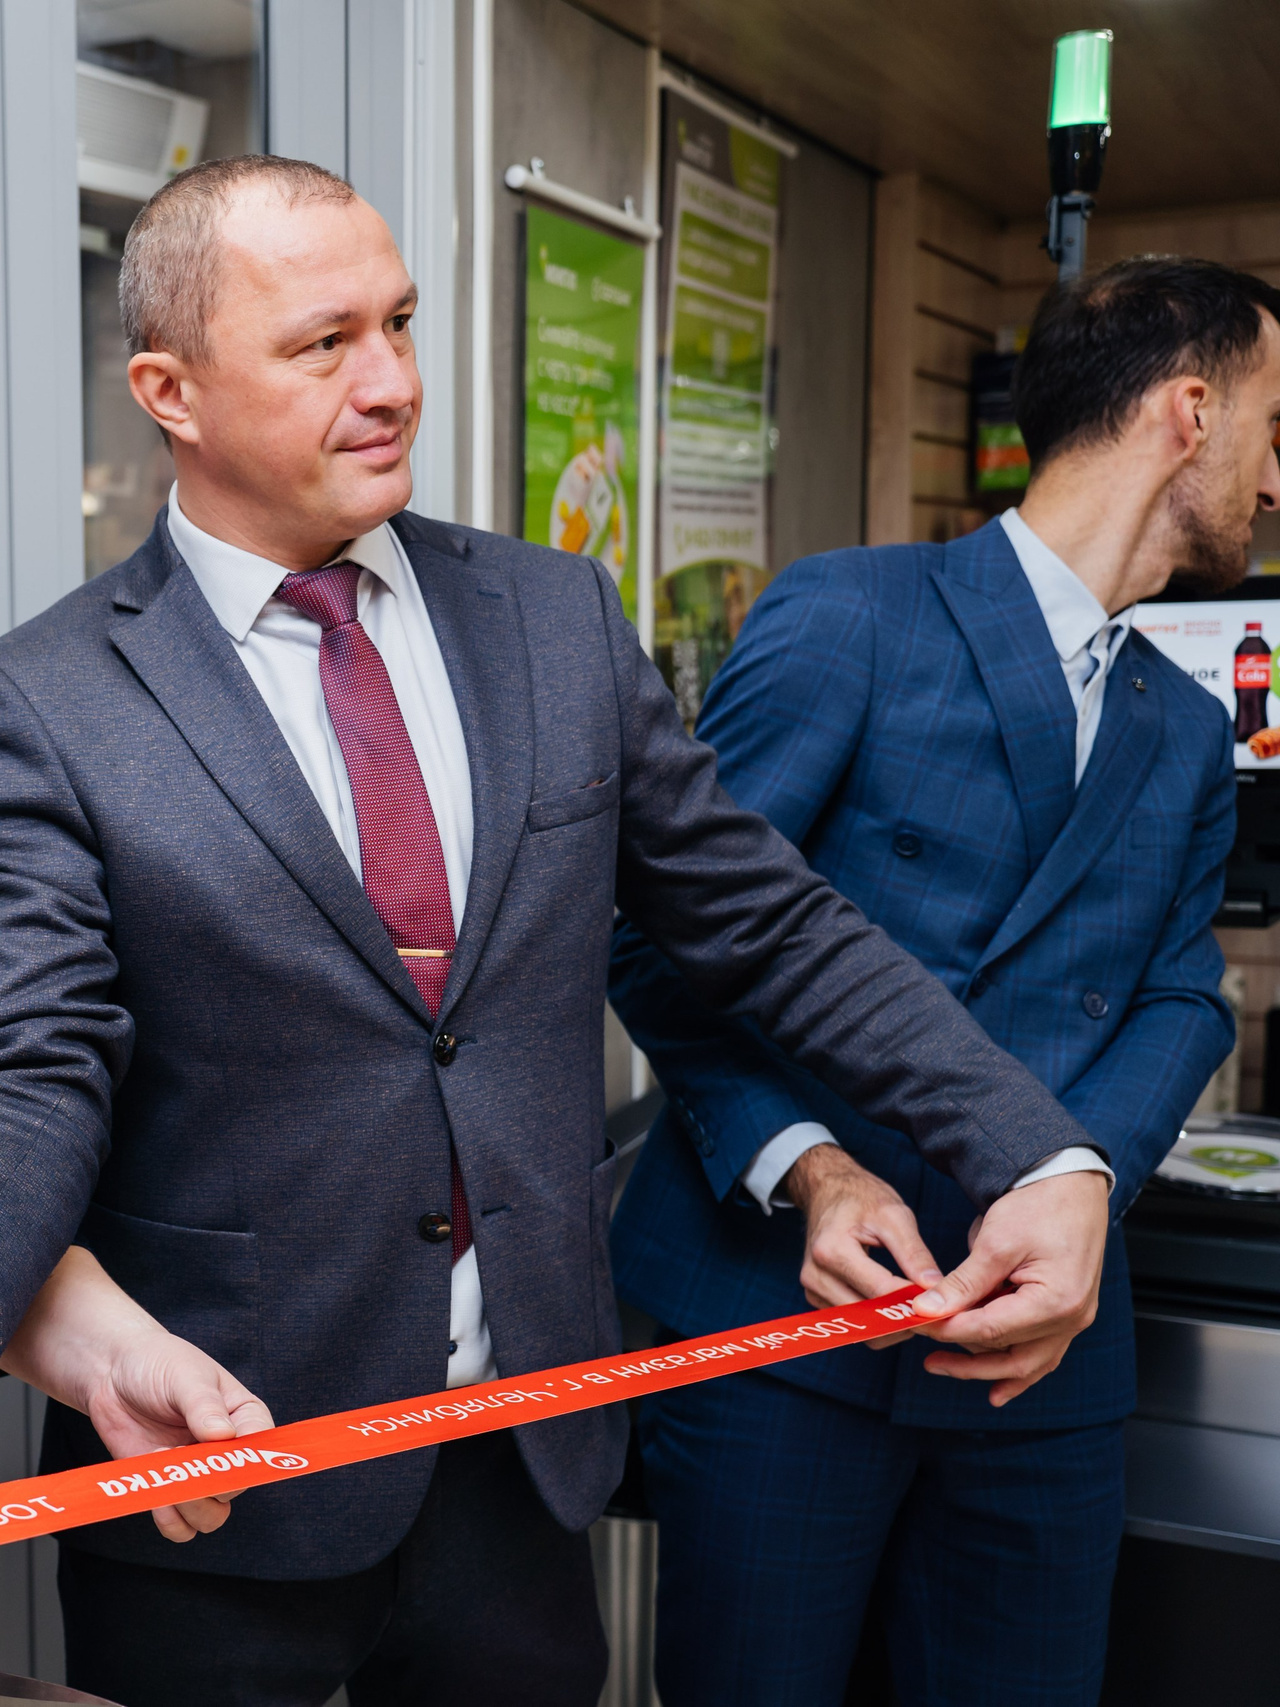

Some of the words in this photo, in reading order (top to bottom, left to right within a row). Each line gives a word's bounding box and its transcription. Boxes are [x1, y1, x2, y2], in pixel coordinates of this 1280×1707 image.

[743, 1317, 866, 1350] 100-ый
[581, 1372, 614, 1384] в
[610, 1341, 749, 1379] магазин
[346, 1389, 558, 1437] Челябинск
[96, 1447, 263, 1498] монетка
